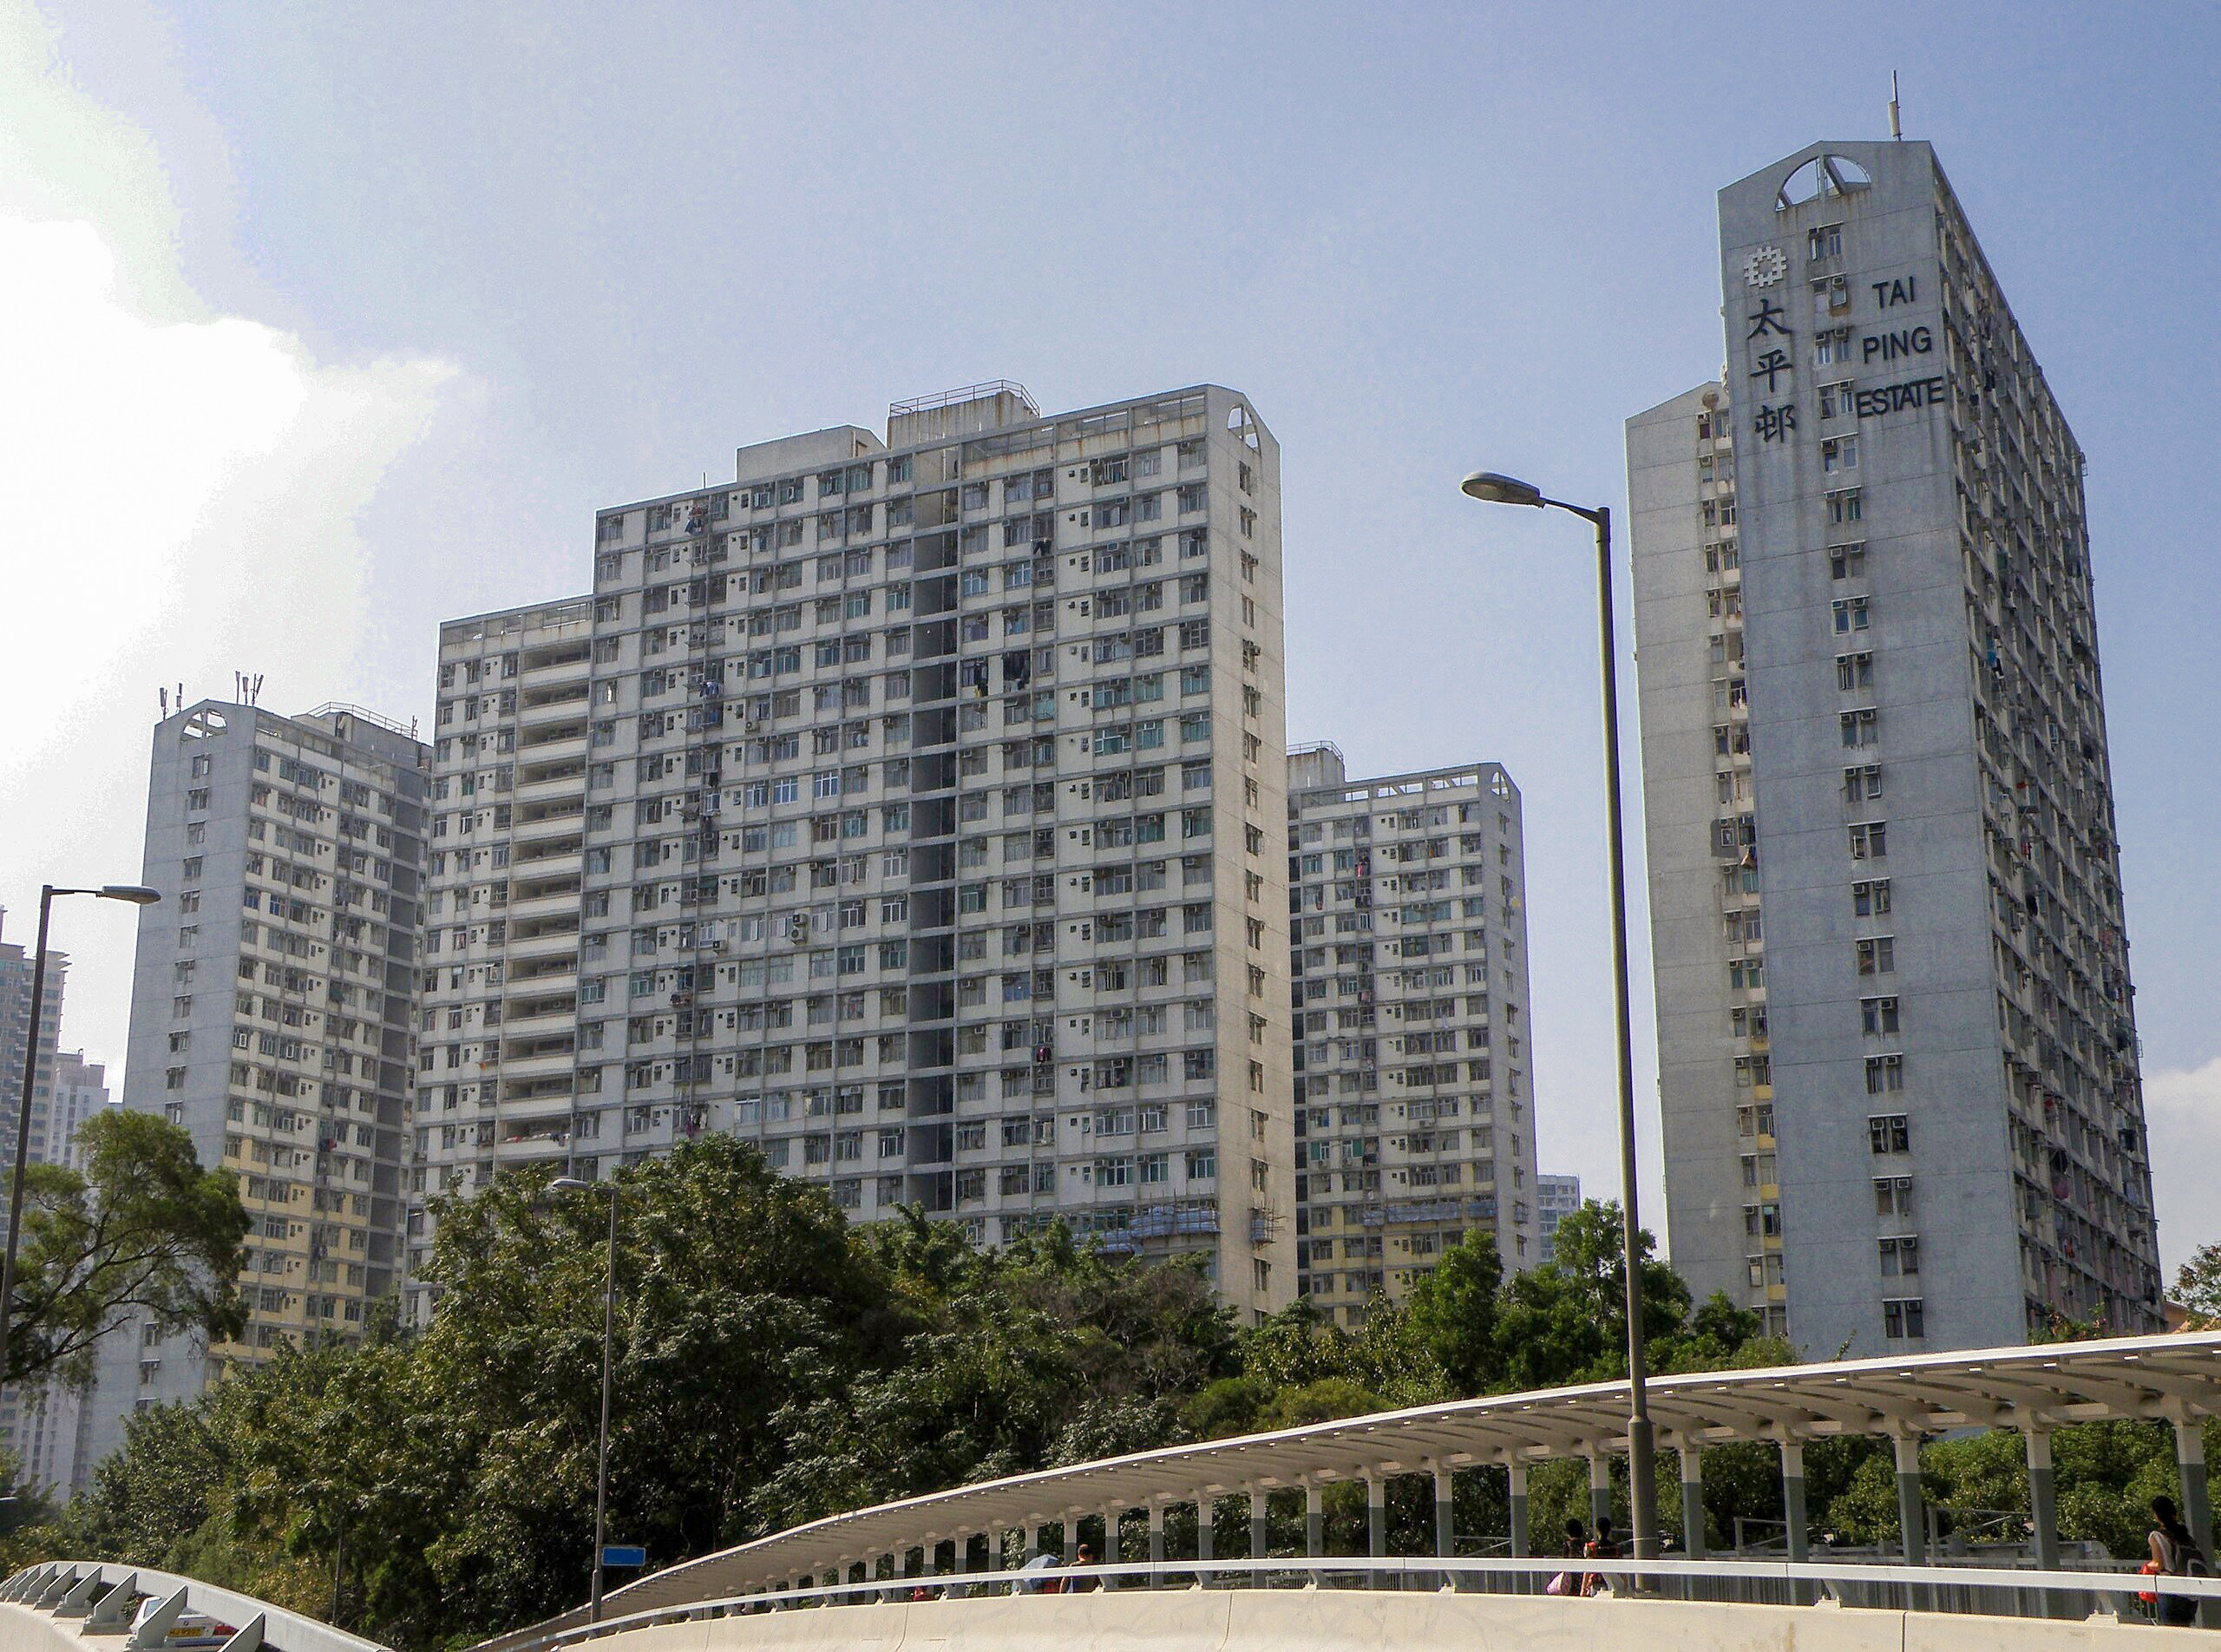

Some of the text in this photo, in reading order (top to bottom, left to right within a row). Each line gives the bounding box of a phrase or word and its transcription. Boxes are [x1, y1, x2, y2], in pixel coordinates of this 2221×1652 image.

[1871, 276, 1916, 309] TAI
[1862, 326, 1933, 364] PING
[1746, 298, 1797, 443] 太平邨
[1857, 376, 1946, 419] ESTATE
